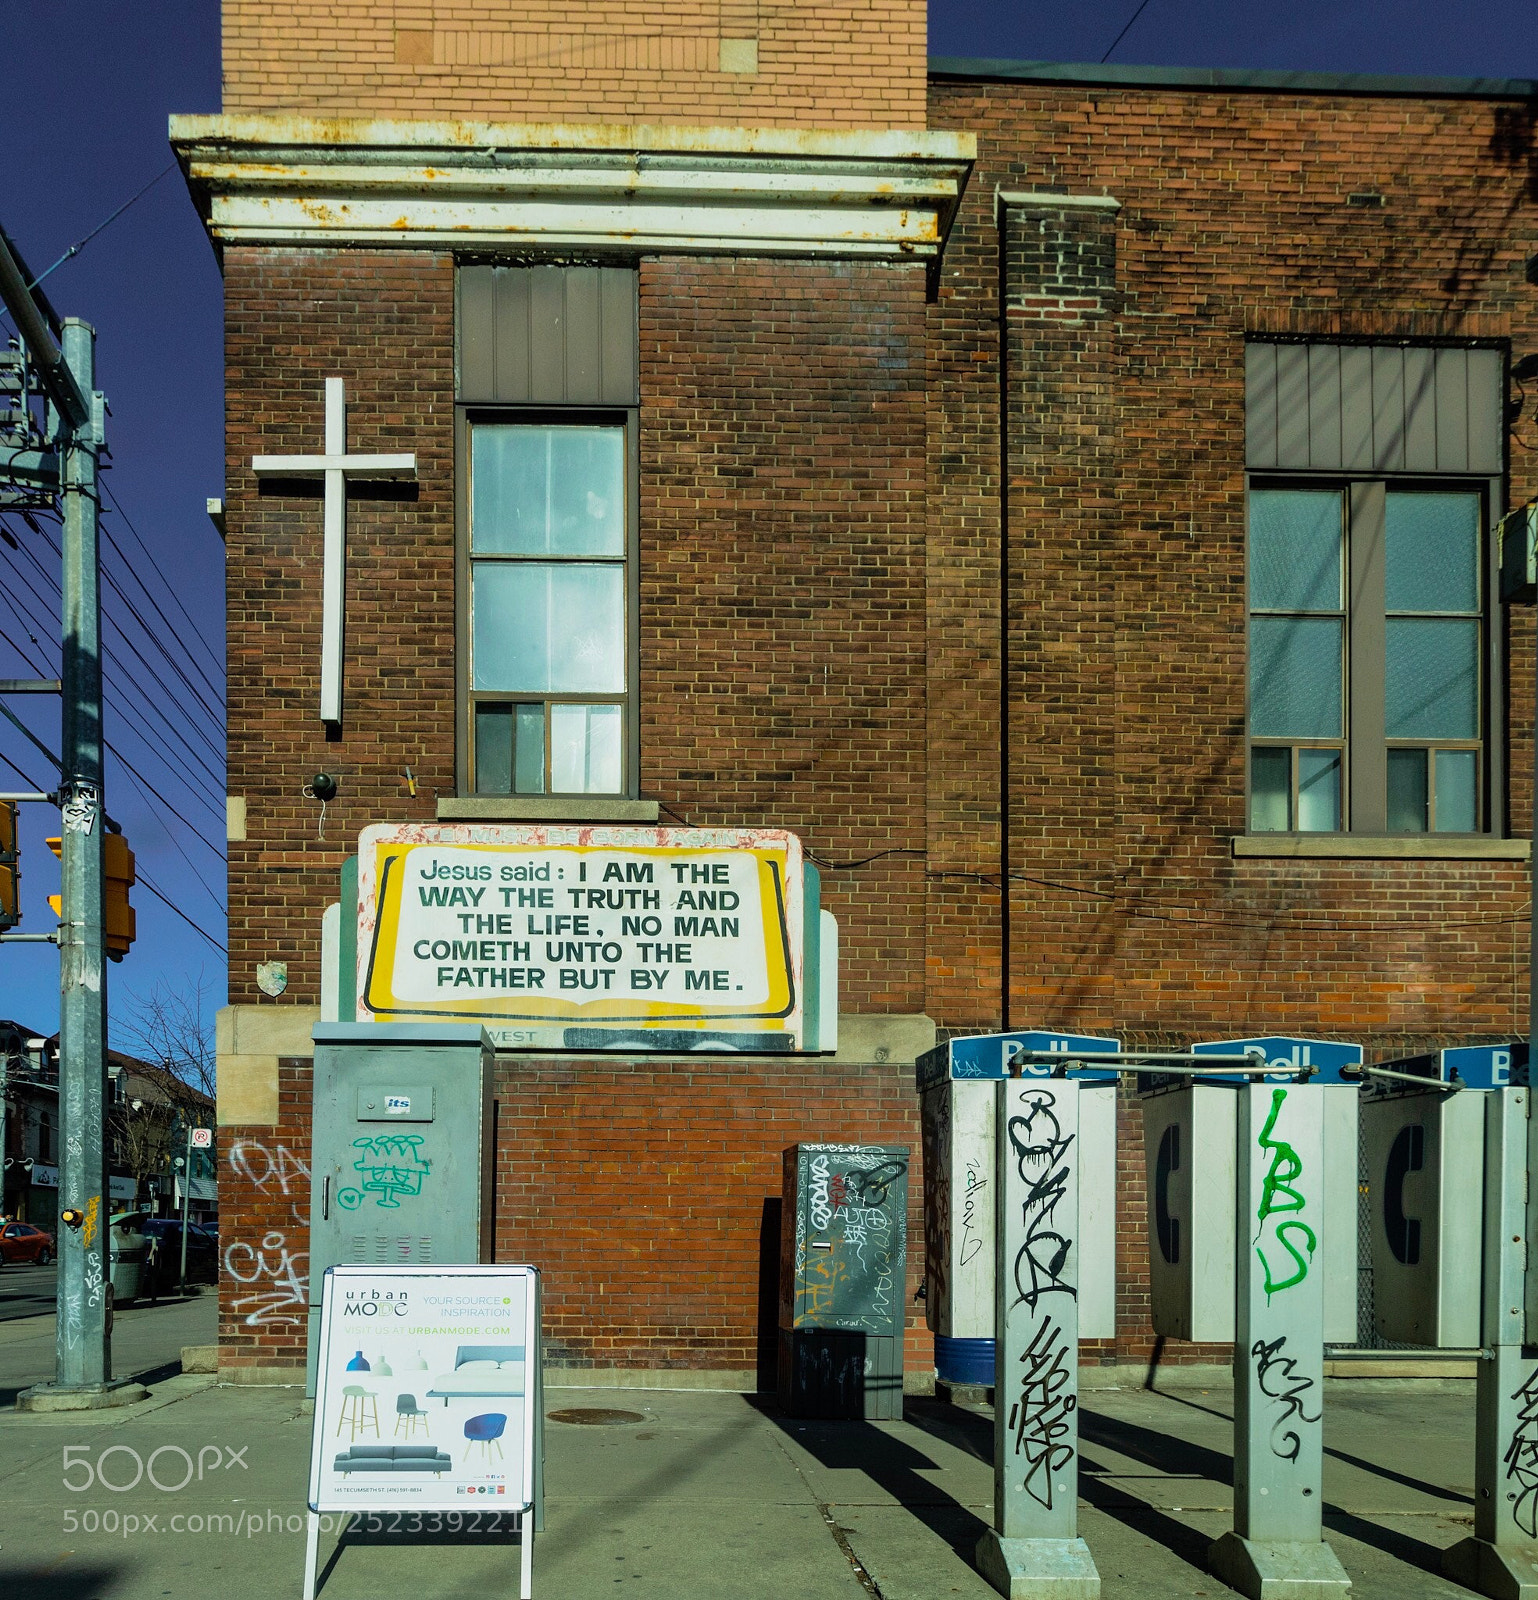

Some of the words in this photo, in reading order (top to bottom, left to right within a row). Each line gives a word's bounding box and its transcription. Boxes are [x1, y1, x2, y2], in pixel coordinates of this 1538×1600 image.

[420, 859, 492, 881] Jesus
[579, 862, 587, 882] I
[602, 863, 654, 883] AM
[671, 863, 730, 884] THE
[418, 887, 486, 907] WAY
[498, 888, 554, 908] THE
[567, 888, 660, 909] TRUTH
[676, 890, 740, 911] AND
[457, 913, 513, 935] THE
[621, 916, 663, 937] NO
[674, 916, 739, 938] MAN
[413, 939, 530, 962] COMETH
[545, 942, 623, 963] UNTO
[637, 942, 691, 964] THE
[437, 966, 545, 990] FATHER
[559, 968, 616, 990] BUT
[630, 969, 669, 990] BY
[685, 969, 743, 991] ME.
[387, 1098, 410, 1108] its
[346, 1289, 408, 1300] urban
[423, 1296, 453, 1305] YOUR
[455, 1296, 501, 1305] SOURCE
[440, 1308, 511, 1317] INSPIRATION
[344, 1327, 372, 1335] VISIT
[375, 1327, 390, 1335] US
[392, 1327, 406, 1335] AT
[408, 1327, 511, 1335] URBANMODE.COM
